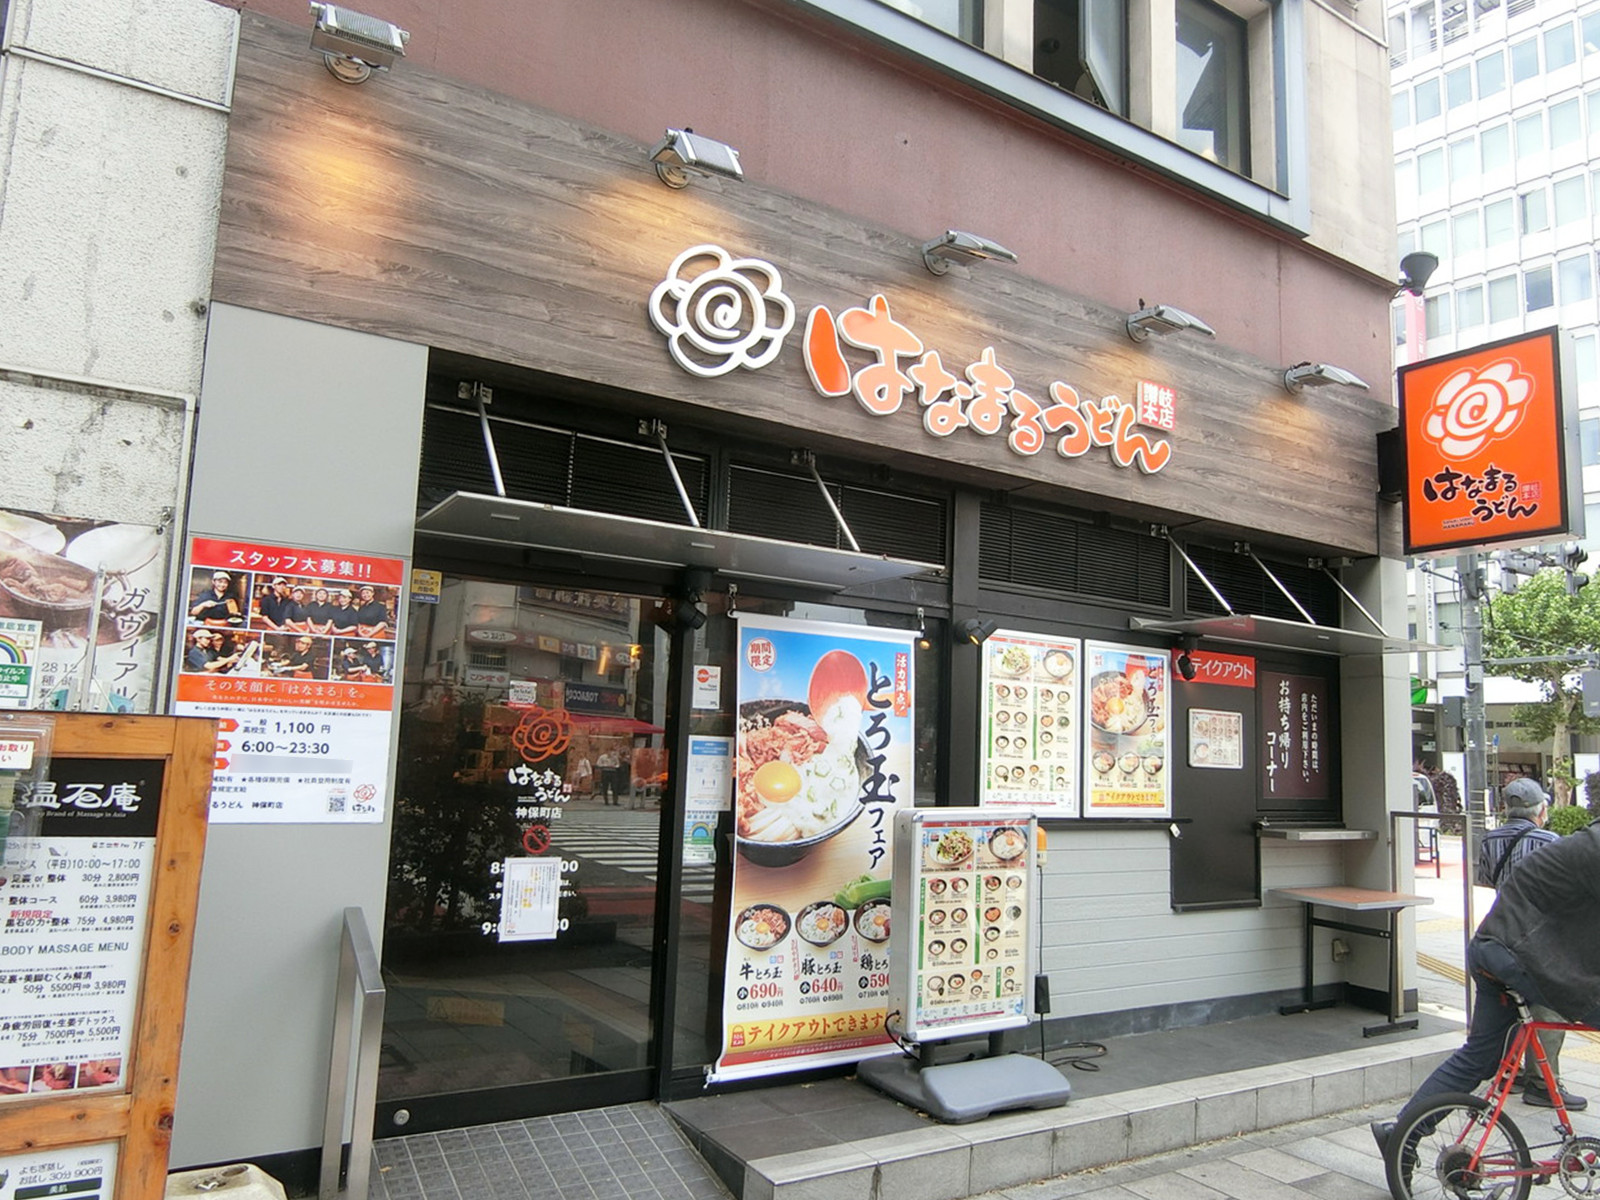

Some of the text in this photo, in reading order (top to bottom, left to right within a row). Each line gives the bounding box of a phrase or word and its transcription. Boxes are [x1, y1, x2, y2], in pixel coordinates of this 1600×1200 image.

[803, 294, 1172, 475] はなまるうどん
[1143, 402, 1174, 429] 本店
[1423, 465, 1518, 502] はなまる
[1471, 496, 1538, 522] うどん
[230, 550, 372, 578] スタッフ大募集!!
[750, 640, 772, 655] 期間
[750, 653, 773, 668] 限定
[1192, 658, 1253, 680] テイクアウト
[205, 679, 366, 699] その笑顔に「はなまる」を。
[275, 721, 315, 735] 1,100
[321, 724, 331, 734] 円
[1278, 680, 1292, 769] お持ち帰り
[859, 661, 901, 870] とろ玉フェア
[1266, 731, 1278, 793] コーナー
[508, 763, 562, 787] はなまる
[535, 786, 571, 803] うどん
[515, 806, 563, 819] 神保町店
[133, 841, 146, 850] 7F
[82, 873, 102, 883] 30分
[108, 873, 140, 883] 2,800円
[8, 894, 137, 905] 整体コース 60分 3,980円
[77, 916, 97, 925] 75分
[103, 915, 135, 925] 4,980円
[1, 941, 130, 956] BODY MASSAGE MENU
[739, 962, 783, 981] 牛とろ玉
[801, 957, 842, 976] 豚とろ玉
[860, 953, 889, 972] 鶏とろ
[23, 984, 44, 994] 50分
[94, 979, 127, 990] 3,980円
[0, 1015, 117, 1031] 身疲労回復・生姜デトックス
[748, 1012, 884, 1045] テイクアウトできます
[17, 1032, 38, 1042] 75分
[49, 1170, 72, 1181] 30分
[74, 1166, 103, 1178] 900円
